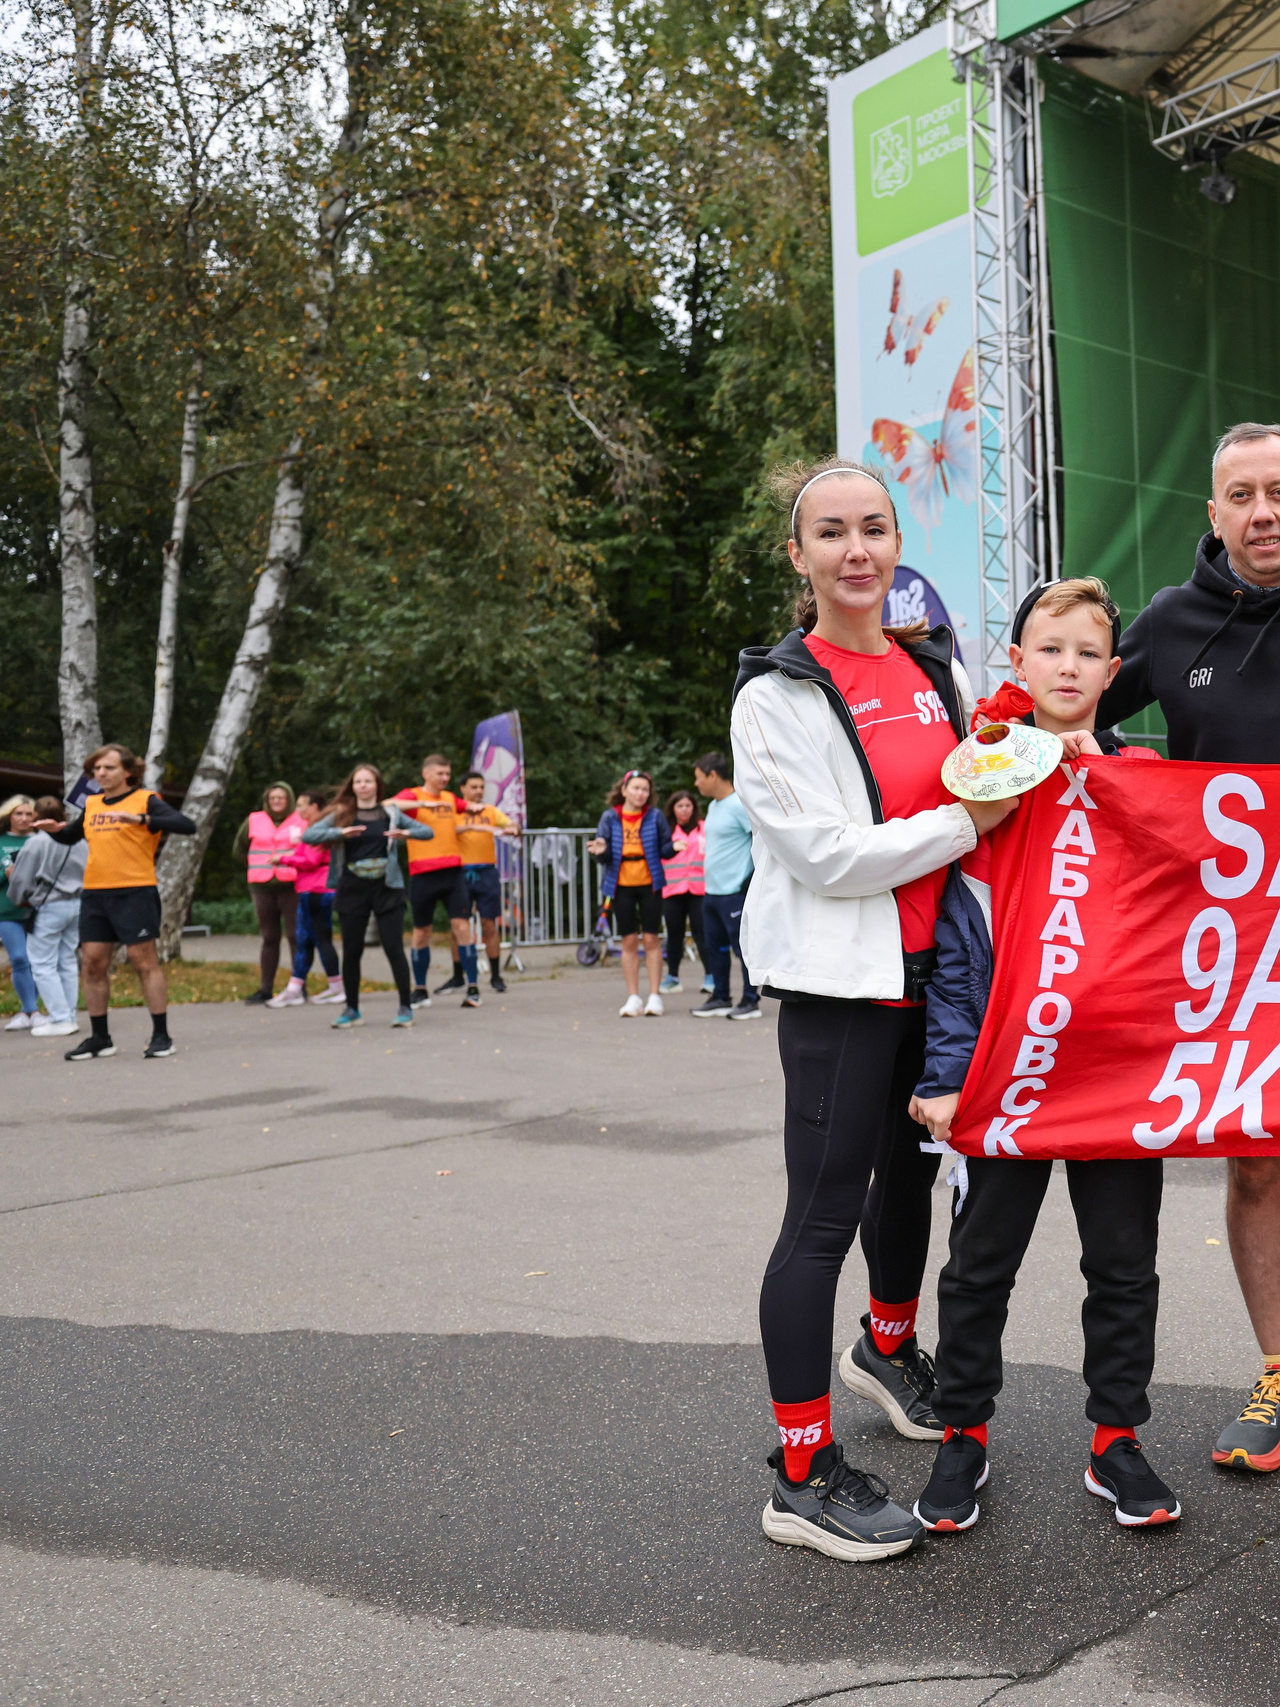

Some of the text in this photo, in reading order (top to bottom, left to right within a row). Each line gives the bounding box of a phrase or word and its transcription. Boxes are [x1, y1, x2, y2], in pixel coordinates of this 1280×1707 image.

[916, 97, 962, 132] ПРОЕКТ
[917, 123, 951, 149] МЭРА
[983, 763, 1098, 1156] ХАБАРОВСК
[778, 1419, 825, 1447] S95
